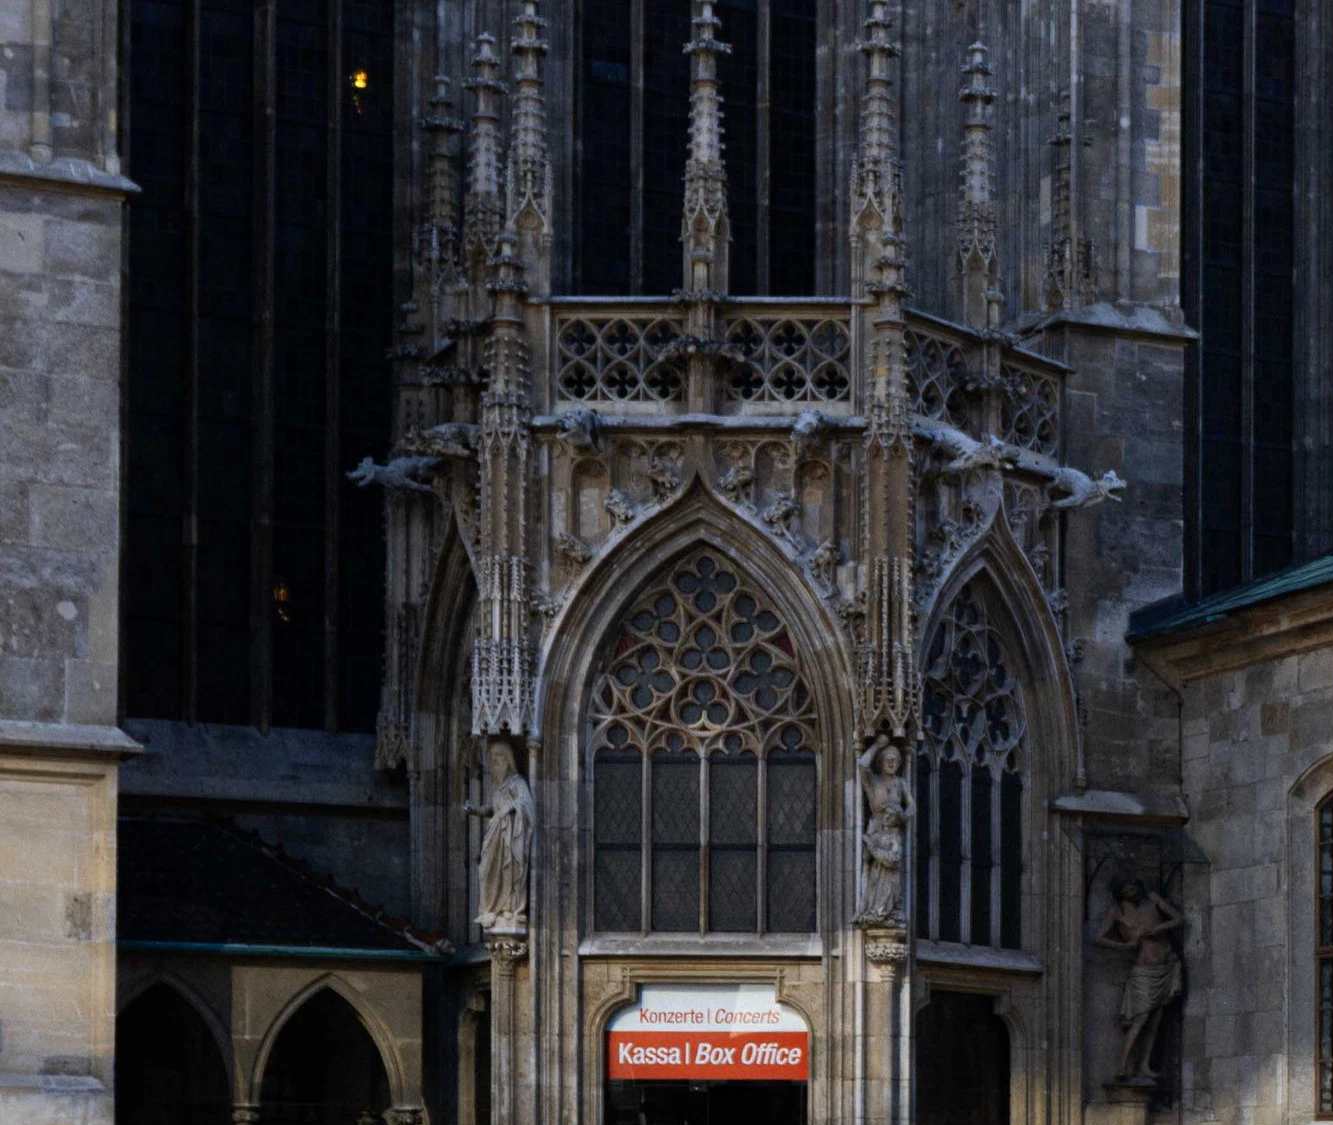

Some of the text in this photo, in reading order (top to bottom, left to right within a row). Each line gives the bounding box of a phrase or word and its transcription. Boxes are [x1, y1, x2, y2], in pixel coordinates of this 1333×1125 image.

[639, 1008, 703, 1024] Konzerte
[714, 1008, 780, 1024] Concerts
[618, 1042, 680, 1065] Kassa
[695, 1042, 735, 1065] Box
[741, 1042, 802, 1065] Office
